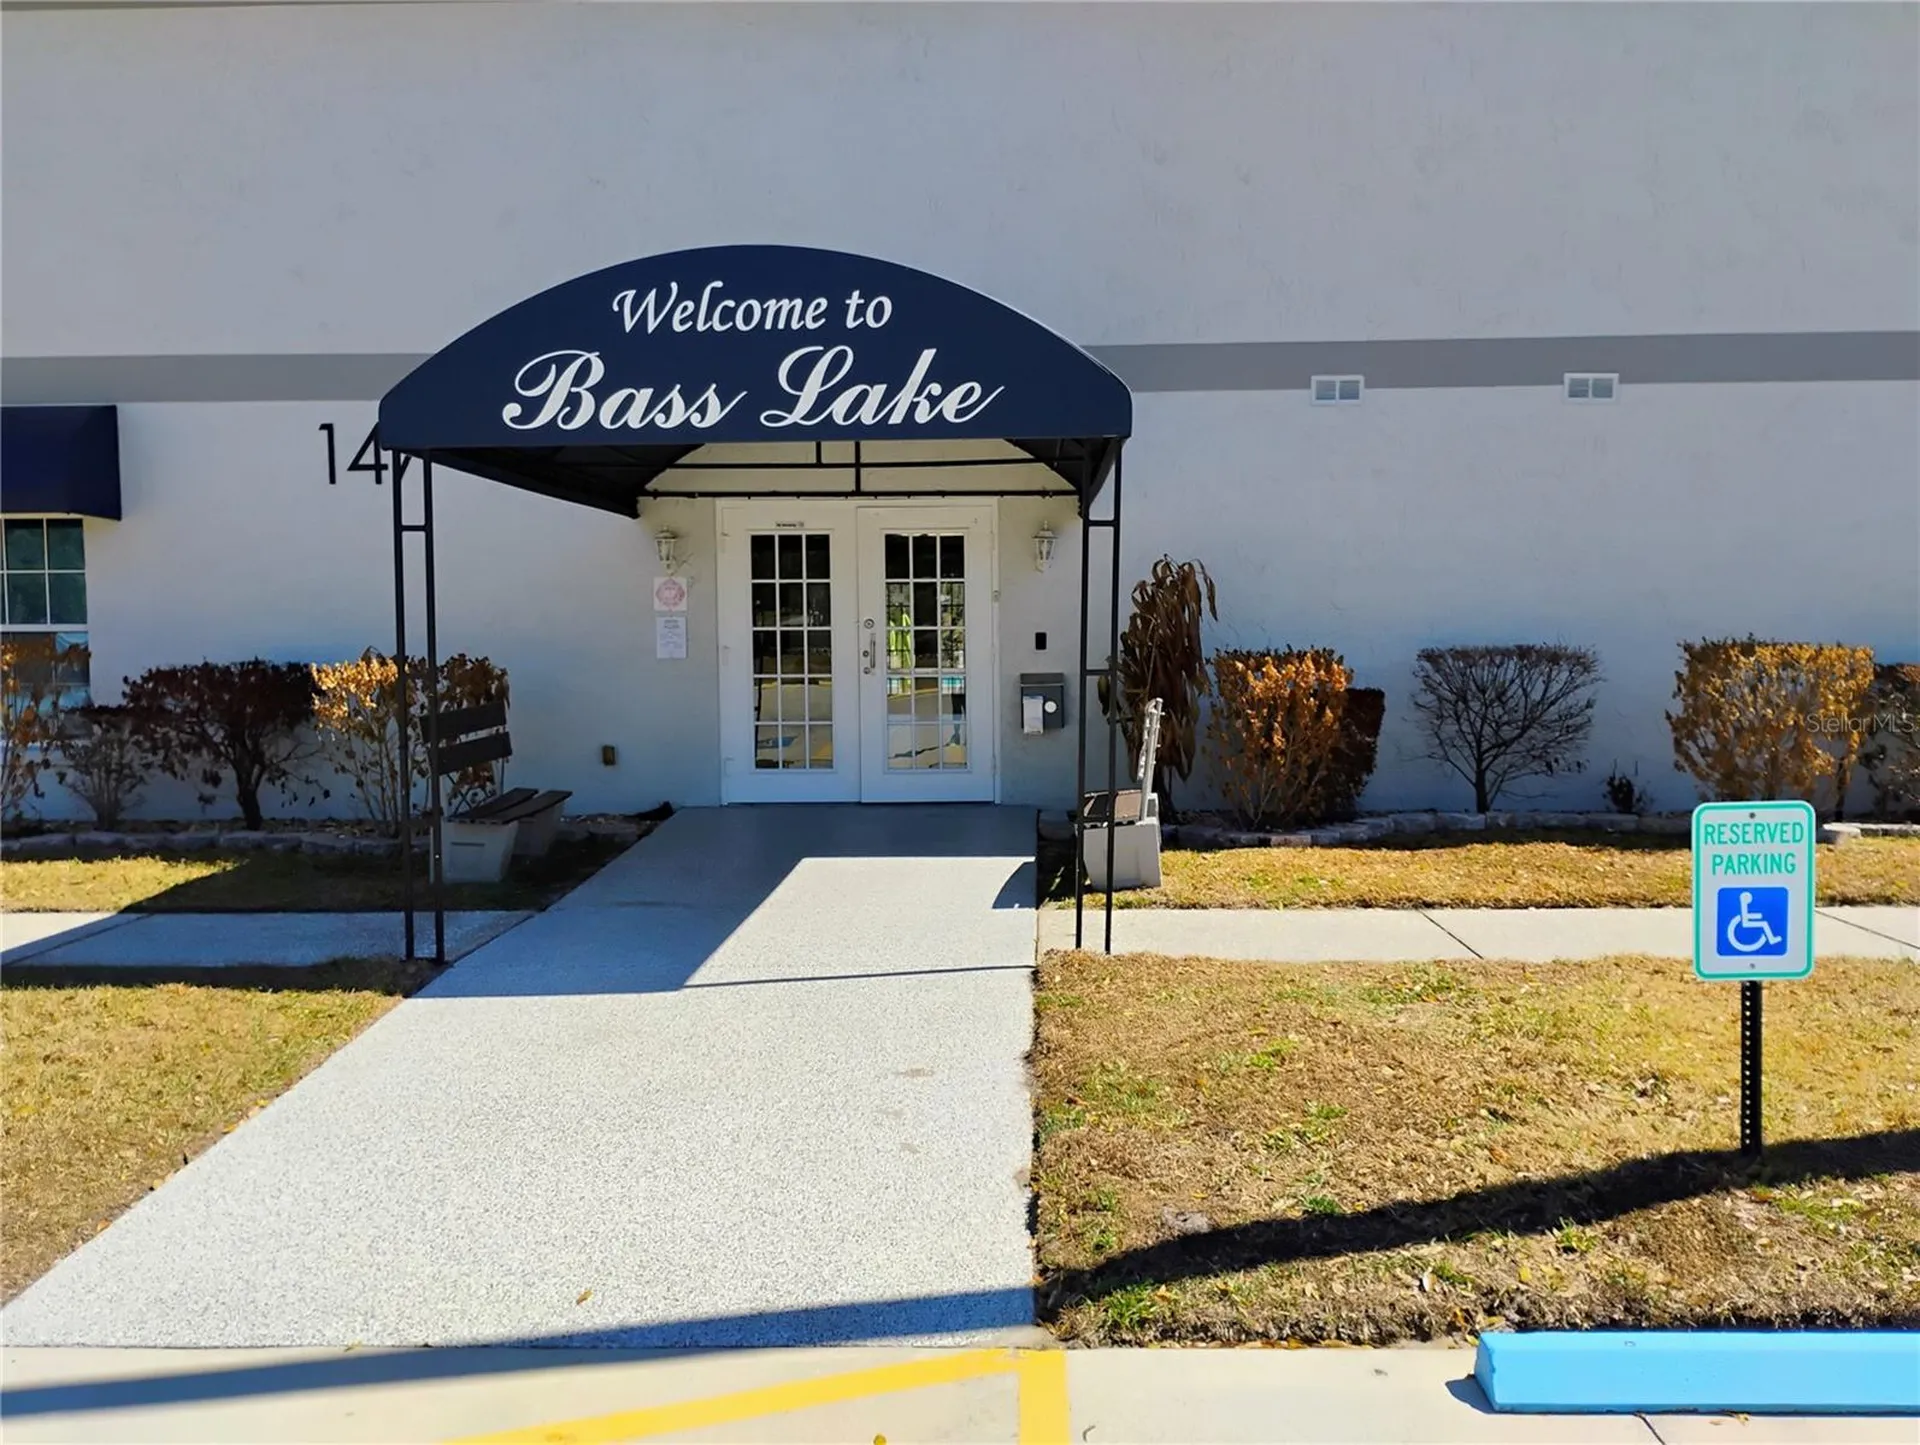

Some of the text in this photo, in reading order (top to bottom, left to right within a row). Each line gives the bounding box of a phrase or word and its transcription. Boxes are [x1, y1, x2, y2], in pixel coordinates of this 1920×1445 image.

[611, 280, 893, 334] Welcome to
[501, 345, 1005, 431] Bass Lake
[1704, 822, 1804, 845] RESERVED
[1712, 853, 1796, 876] PARKING
